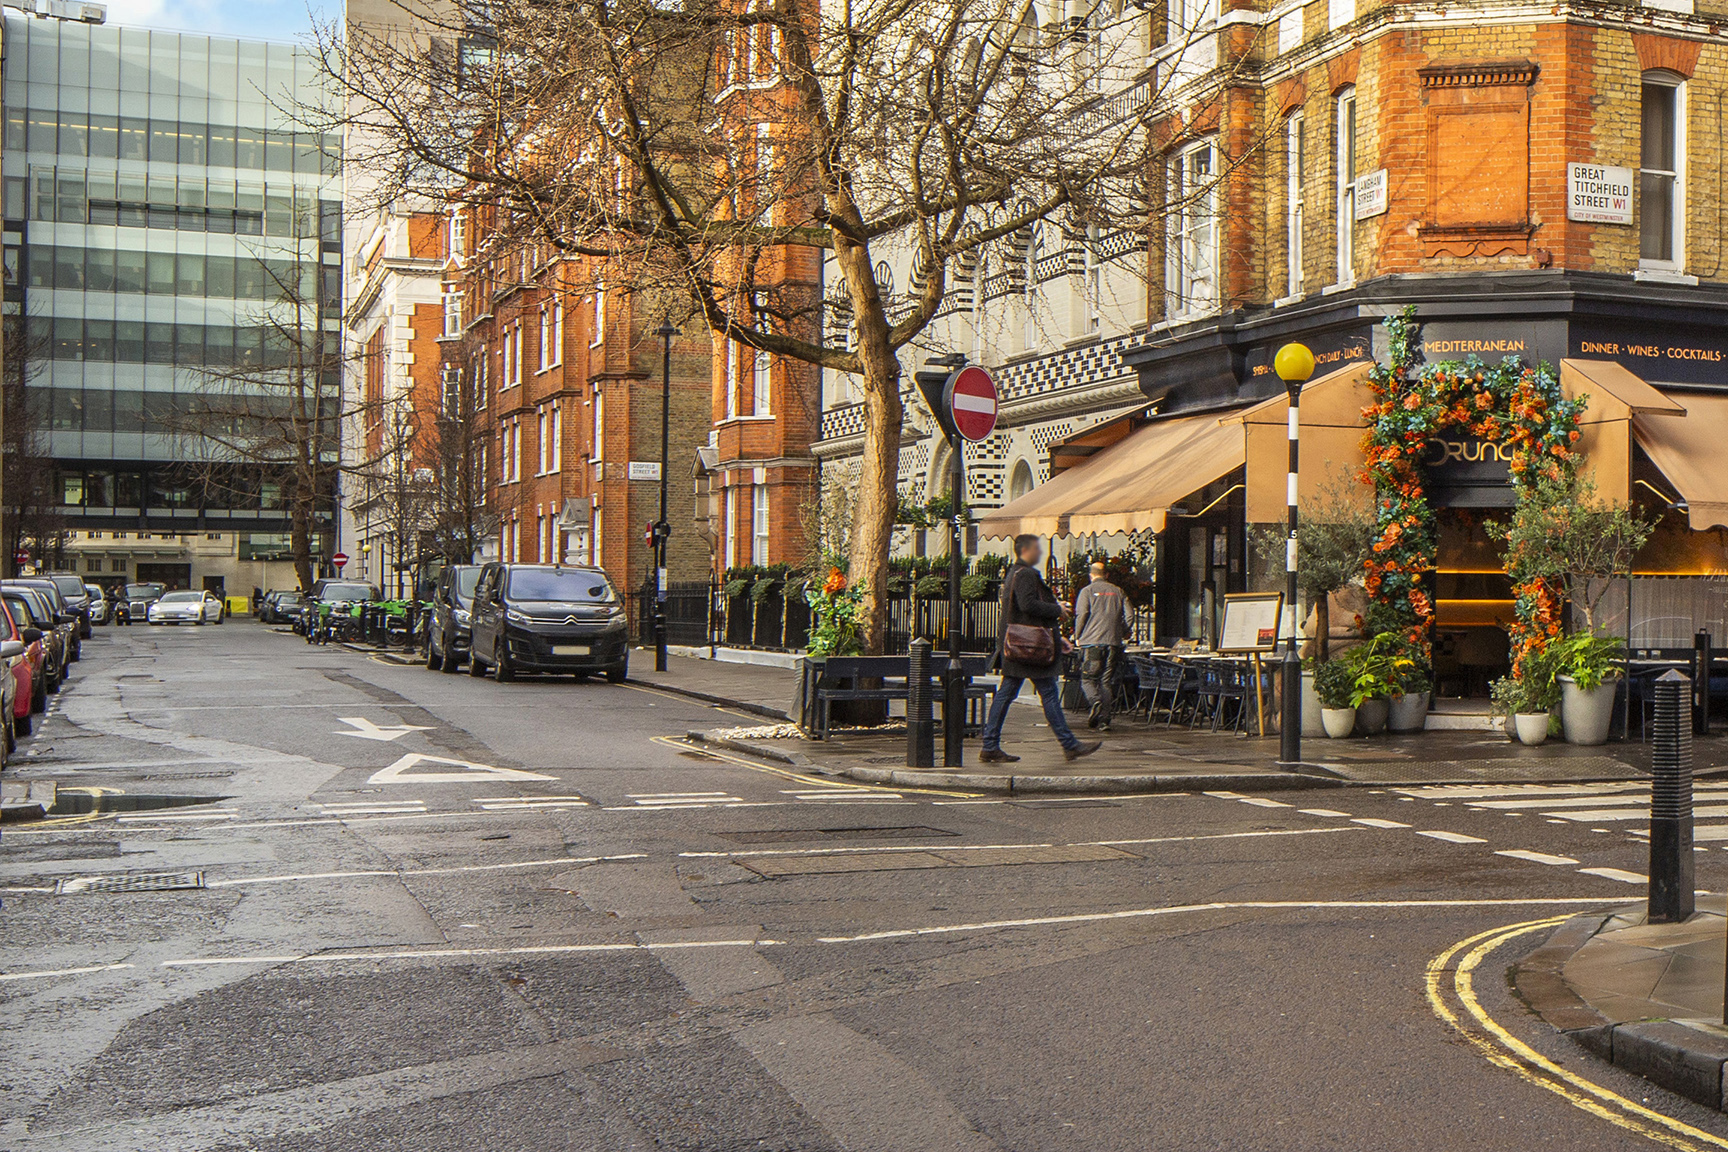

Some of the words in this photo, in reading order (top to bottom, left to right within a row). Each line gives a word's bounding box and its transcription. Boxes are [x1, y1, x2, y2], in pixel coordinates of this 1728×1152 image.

[1574, 167, 1605, 180] GREAT
[1574, 181, 1629, 196] TITCHFIELD
[1574, 194, 1610, 208] STREET
[1613, 198, 1626, 209] W1
[1424, 340, 1524, 353] MEDITERRANEAN
[1581, 341, 1619, 354] DINNER
[1627, 344, 1659, 357] WINES
[1667, 347, 1721, 361] COCKTAILS
